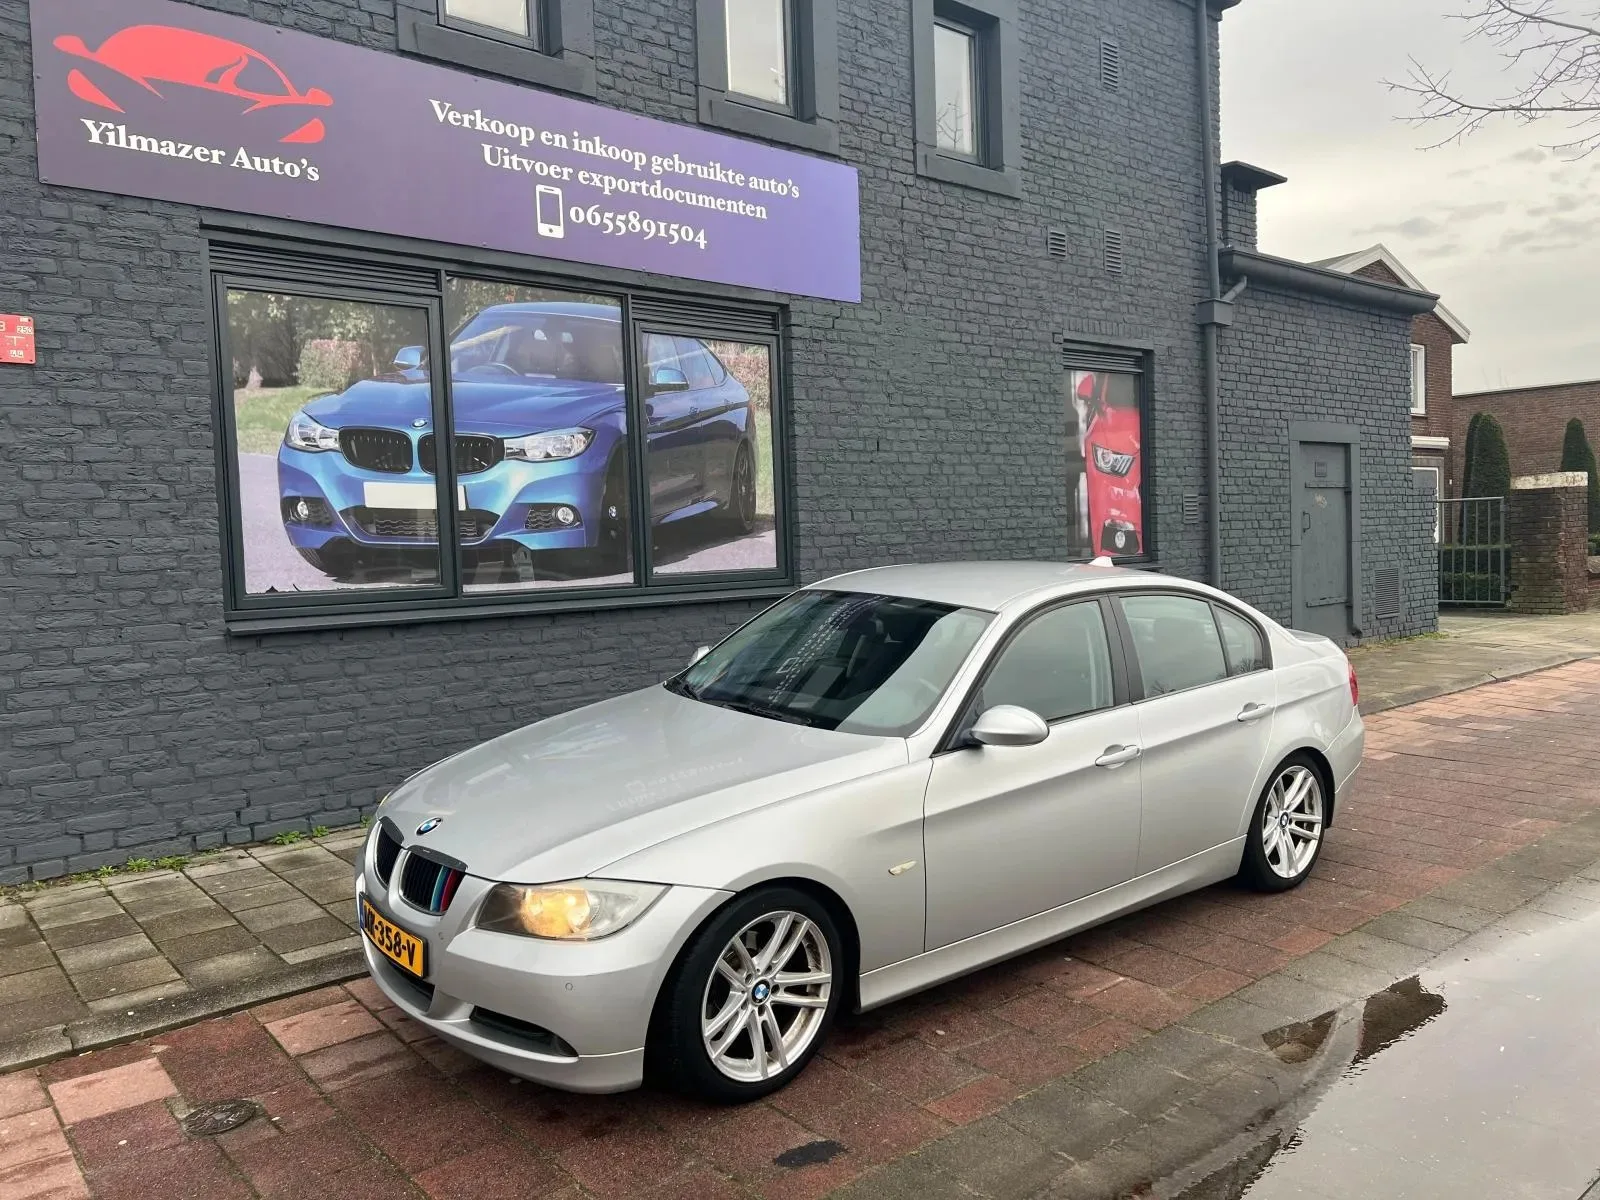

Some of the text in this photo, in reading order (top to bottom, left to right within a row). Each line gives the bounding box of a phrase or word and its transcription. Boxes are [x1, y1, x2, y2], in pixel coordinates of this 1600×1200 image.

[80, 118, 320, 182] Yilmazer Auto's
[429, 99, 800, 199] Verkoop en inkoop gebruikte auto's
[481, 143, 768, 221] Uitvoer exportdocumenten
[568, 205, 708, 250] 0655891504
